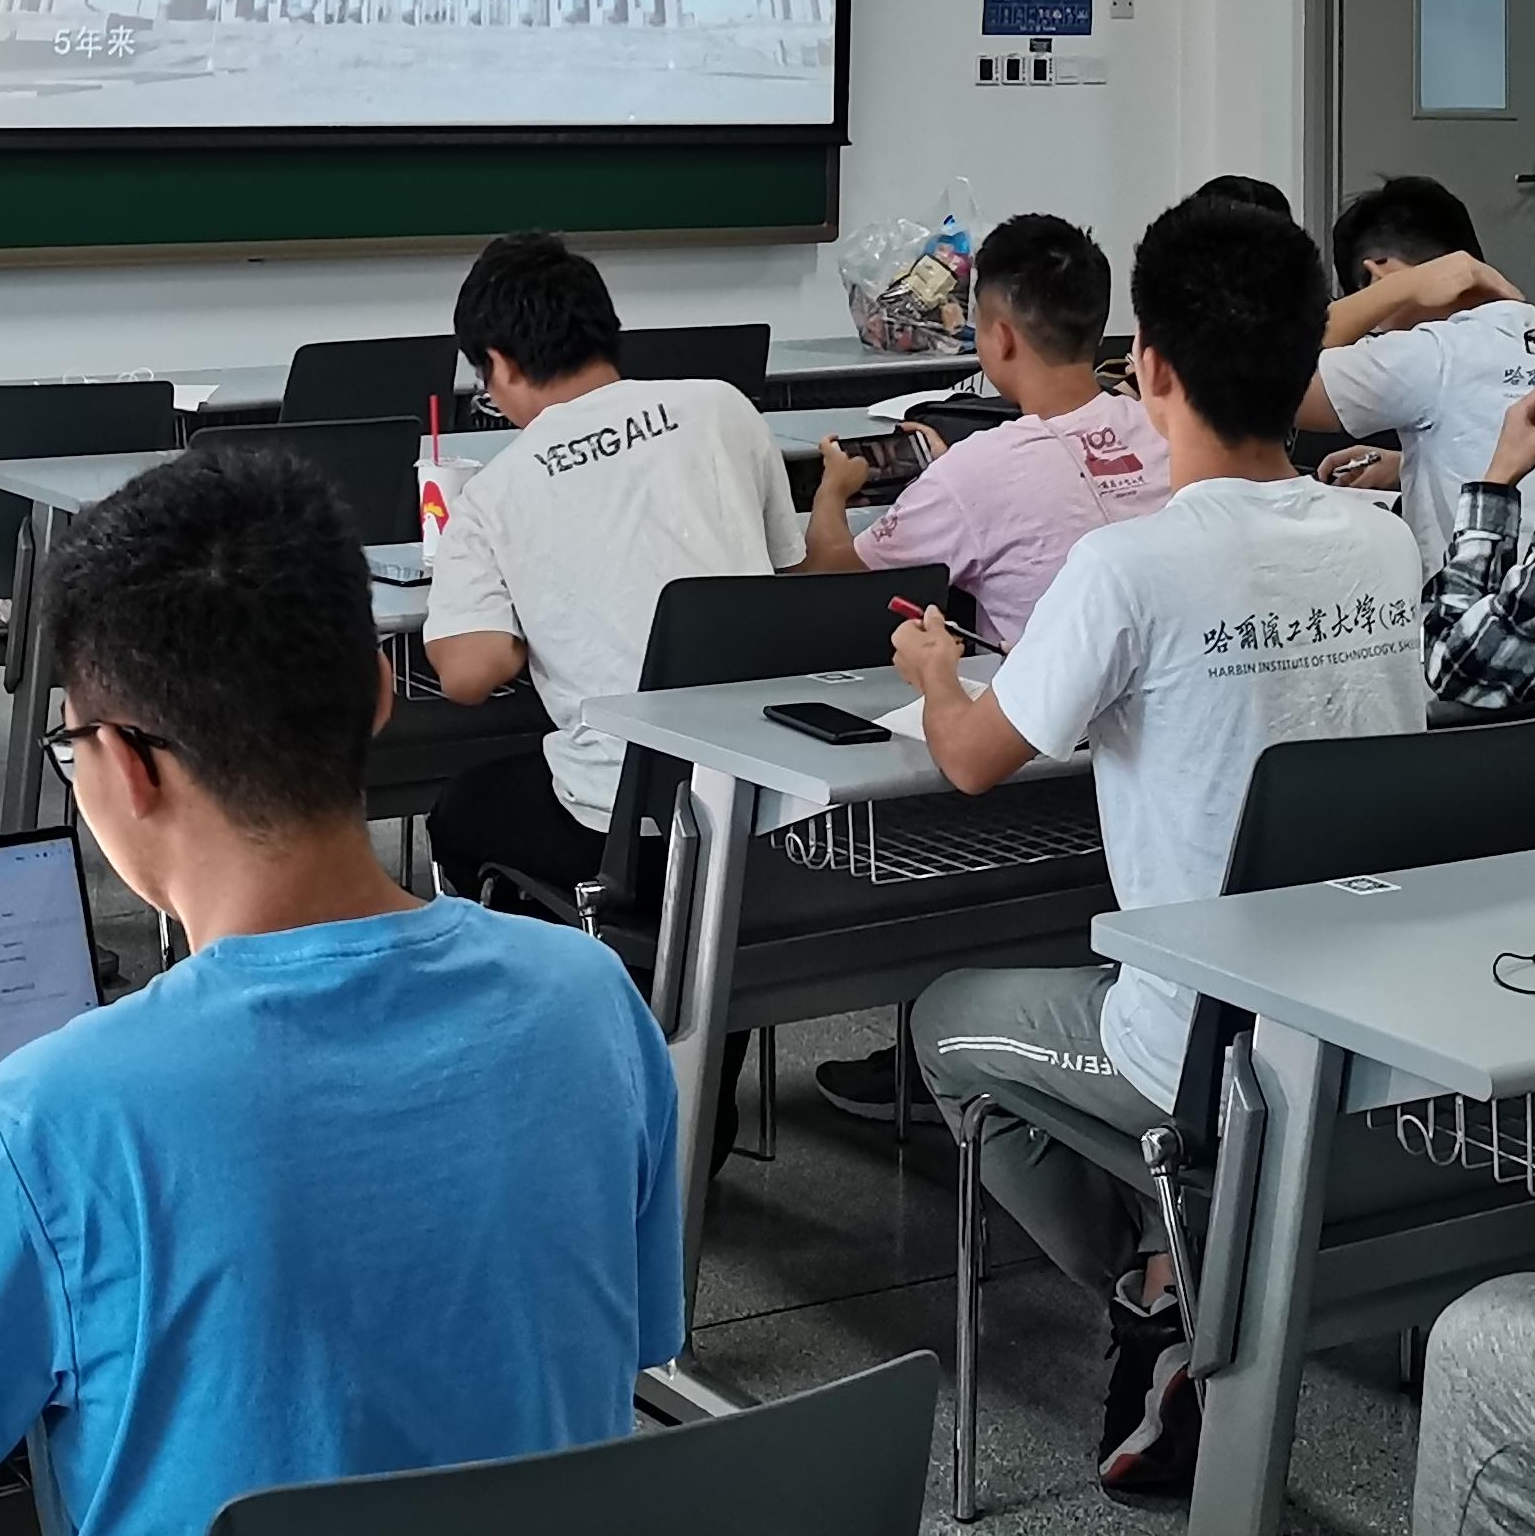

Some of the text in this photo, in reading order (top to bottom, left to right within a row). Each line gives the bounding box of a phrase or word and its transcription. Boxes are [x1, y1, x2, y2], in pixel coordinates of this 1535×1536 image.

[53, 25, 136, 59] 5年来
[1208, 663, 1256, 678] HARBIN
[1258, 656, 1310, 674] INSTITUTE
[1311, 654, 1325, 667] OF
